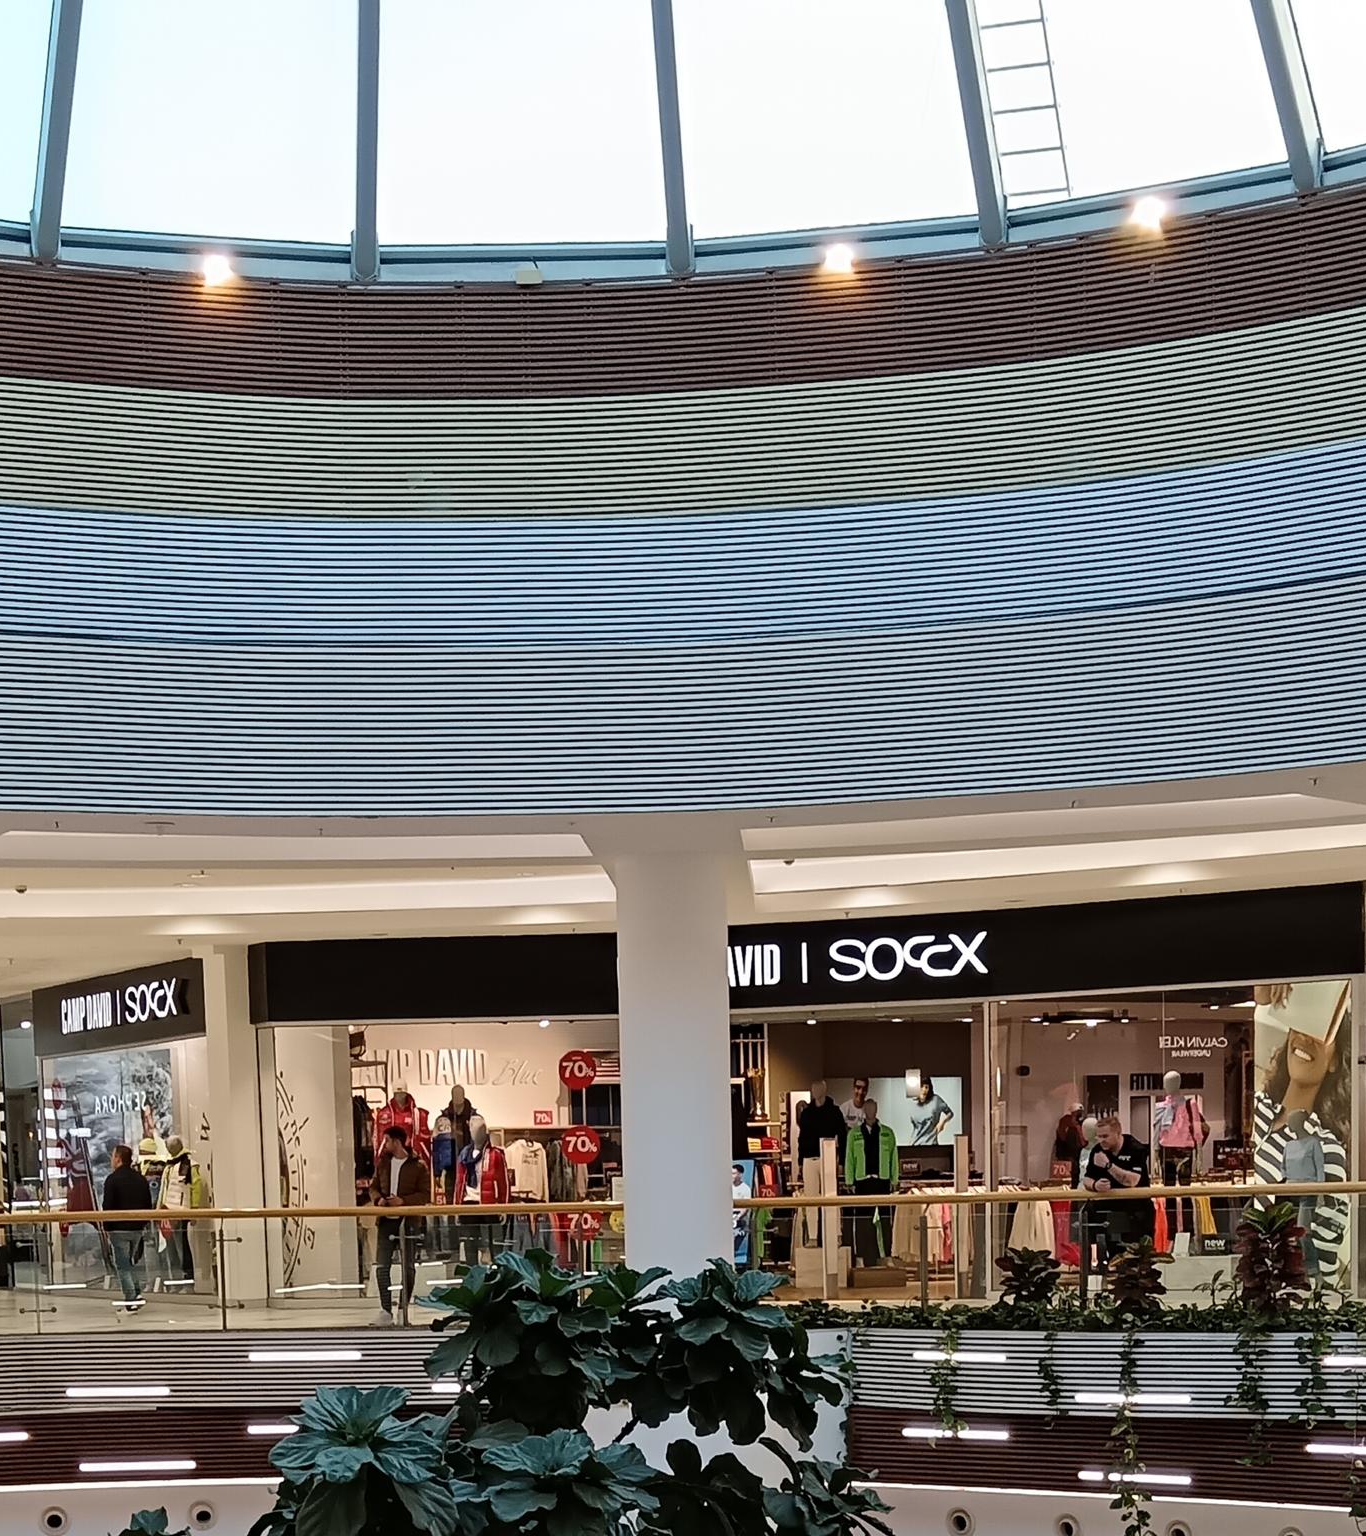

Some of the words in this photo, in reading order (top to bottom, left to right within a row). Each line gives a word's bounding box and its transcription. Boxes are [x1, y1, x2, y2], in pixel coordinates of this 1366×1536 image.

[828, 930, 989, 982] SOCCX
[61, 996, 86, 1035] CAMP
[86, 991, 113, 1030] DAVID
[419, 1048, 489, 1086] DAVID
[562, 1060, 595, 1078] 70%
[565, 1135, 598, 1153] 70%
[1204, 1239, 1226, 1247] new
